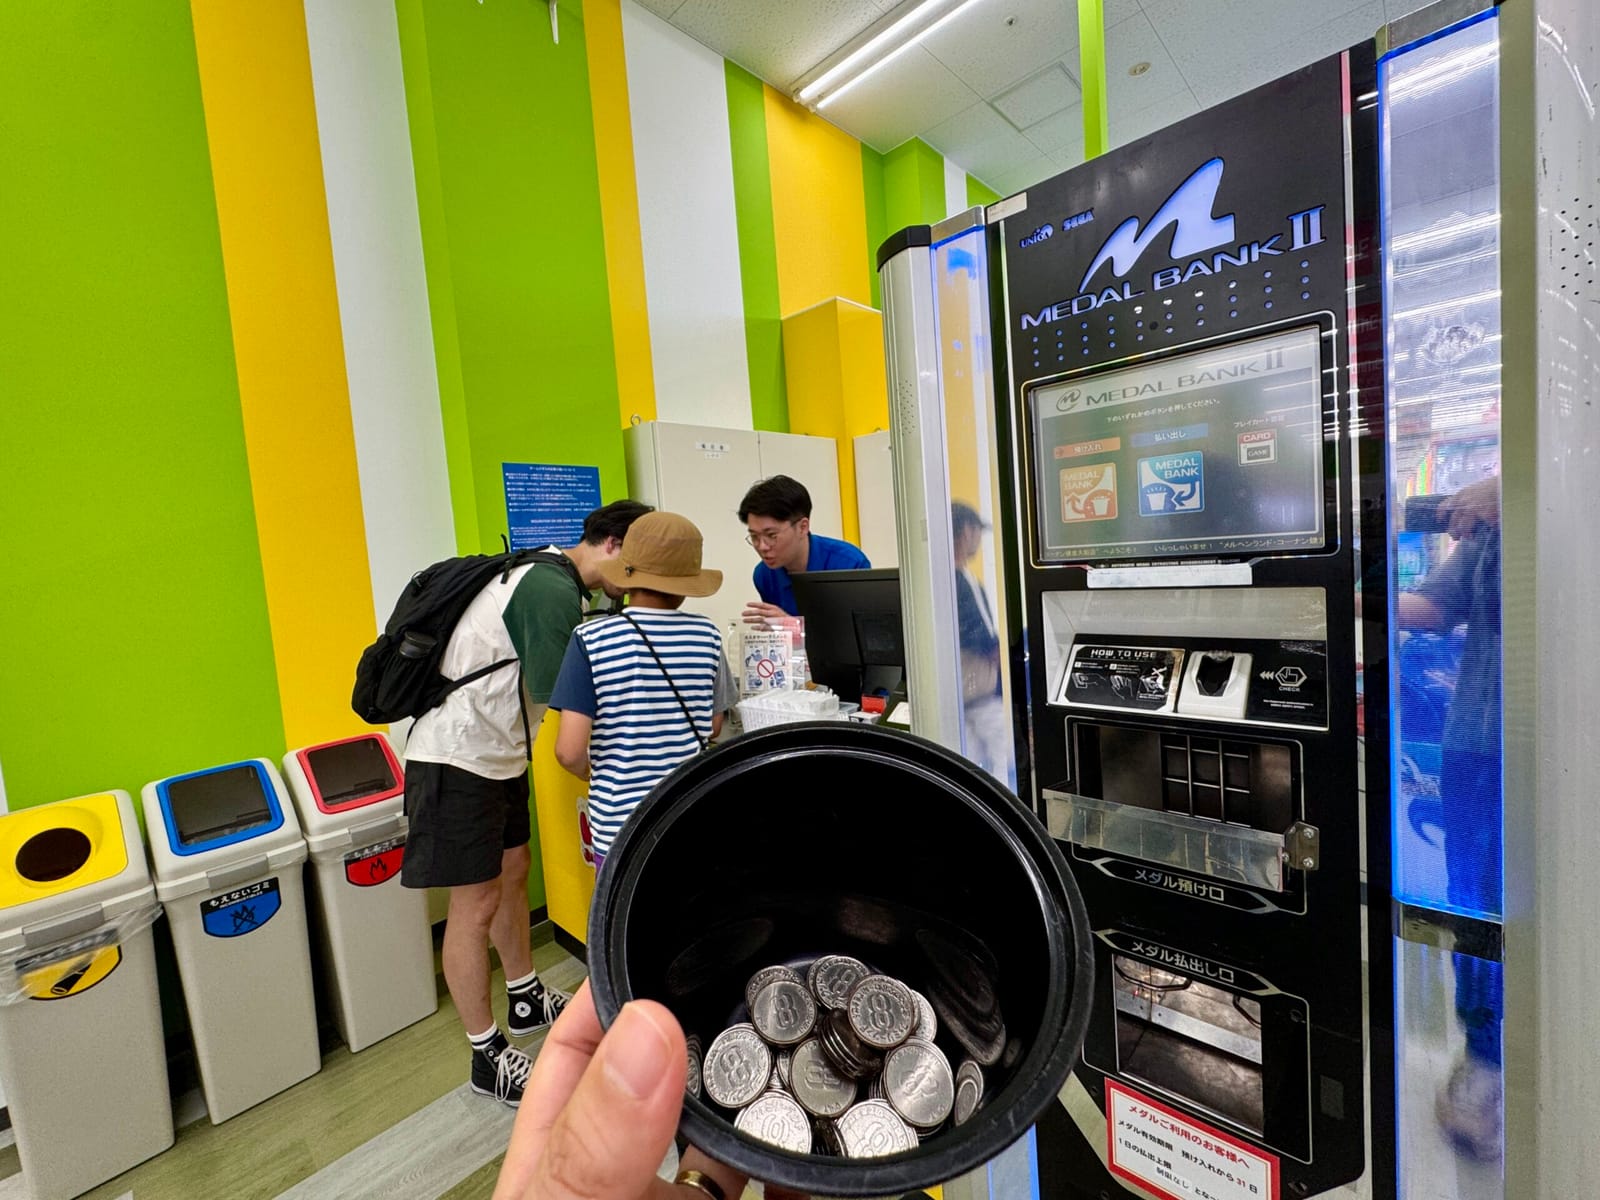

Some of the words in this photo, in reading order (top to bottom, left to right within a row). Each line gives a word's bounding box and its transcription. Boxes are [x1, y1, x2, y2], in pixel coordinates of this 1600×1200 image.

[1020, 281, 1146, 331] MEDAL
[1153, 233, 1285, 292] BANK
[1086, 380, 1172, 407] MEDAL
[1178, 361, 1260, 388] BANK
[1154, 429, 1187, 442] 払い出し
[1243, 431, 1271, 442] CARD
[1155, 456, 1200, 471] MEDAL
[1164, 467, 1200, 480] BANK
[1063, 470, 1100, 481] MEDAL
[1064, 480, 1093, 490] BANK
[1091, 648, 1114, 657] HOW
[1117, 649, 1132, 657] TO
[1134, 651, 1157, 659] USE
[209, 880, 271, 907] もえないゴミ
[1134, 869, 1225, 902] メダル預け口
[1131, 940, 1235, 984] メダル払出し口
[1118, 1119, 1174, 1152] メダル有効期限
[1128, 1105, 1250, 1169] メダルご利用のお客様へ
